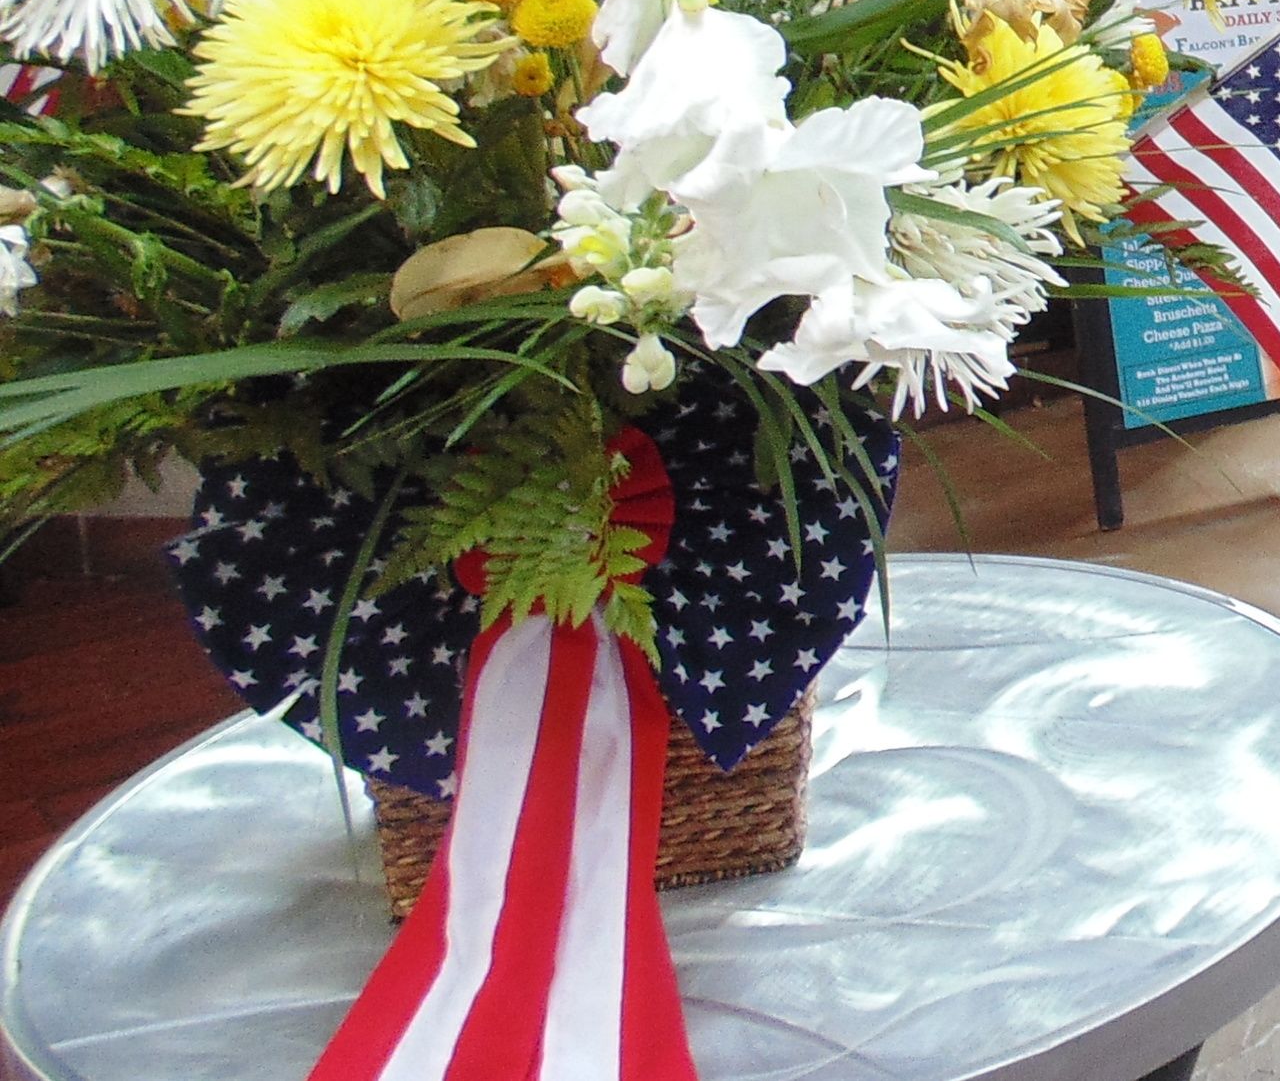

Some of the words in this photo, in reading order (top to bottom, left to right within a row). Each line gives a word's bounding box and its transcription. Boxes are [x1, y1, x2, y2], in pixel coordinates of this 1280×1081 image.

[1225, 11, 1272, 28] DAILY
[1143, 326, 1190, 344] Cheese
[1181, 361, 1203, 370] When
[1203, 358, 1217, 366] You
[1155, 385, 1171, 395] And
